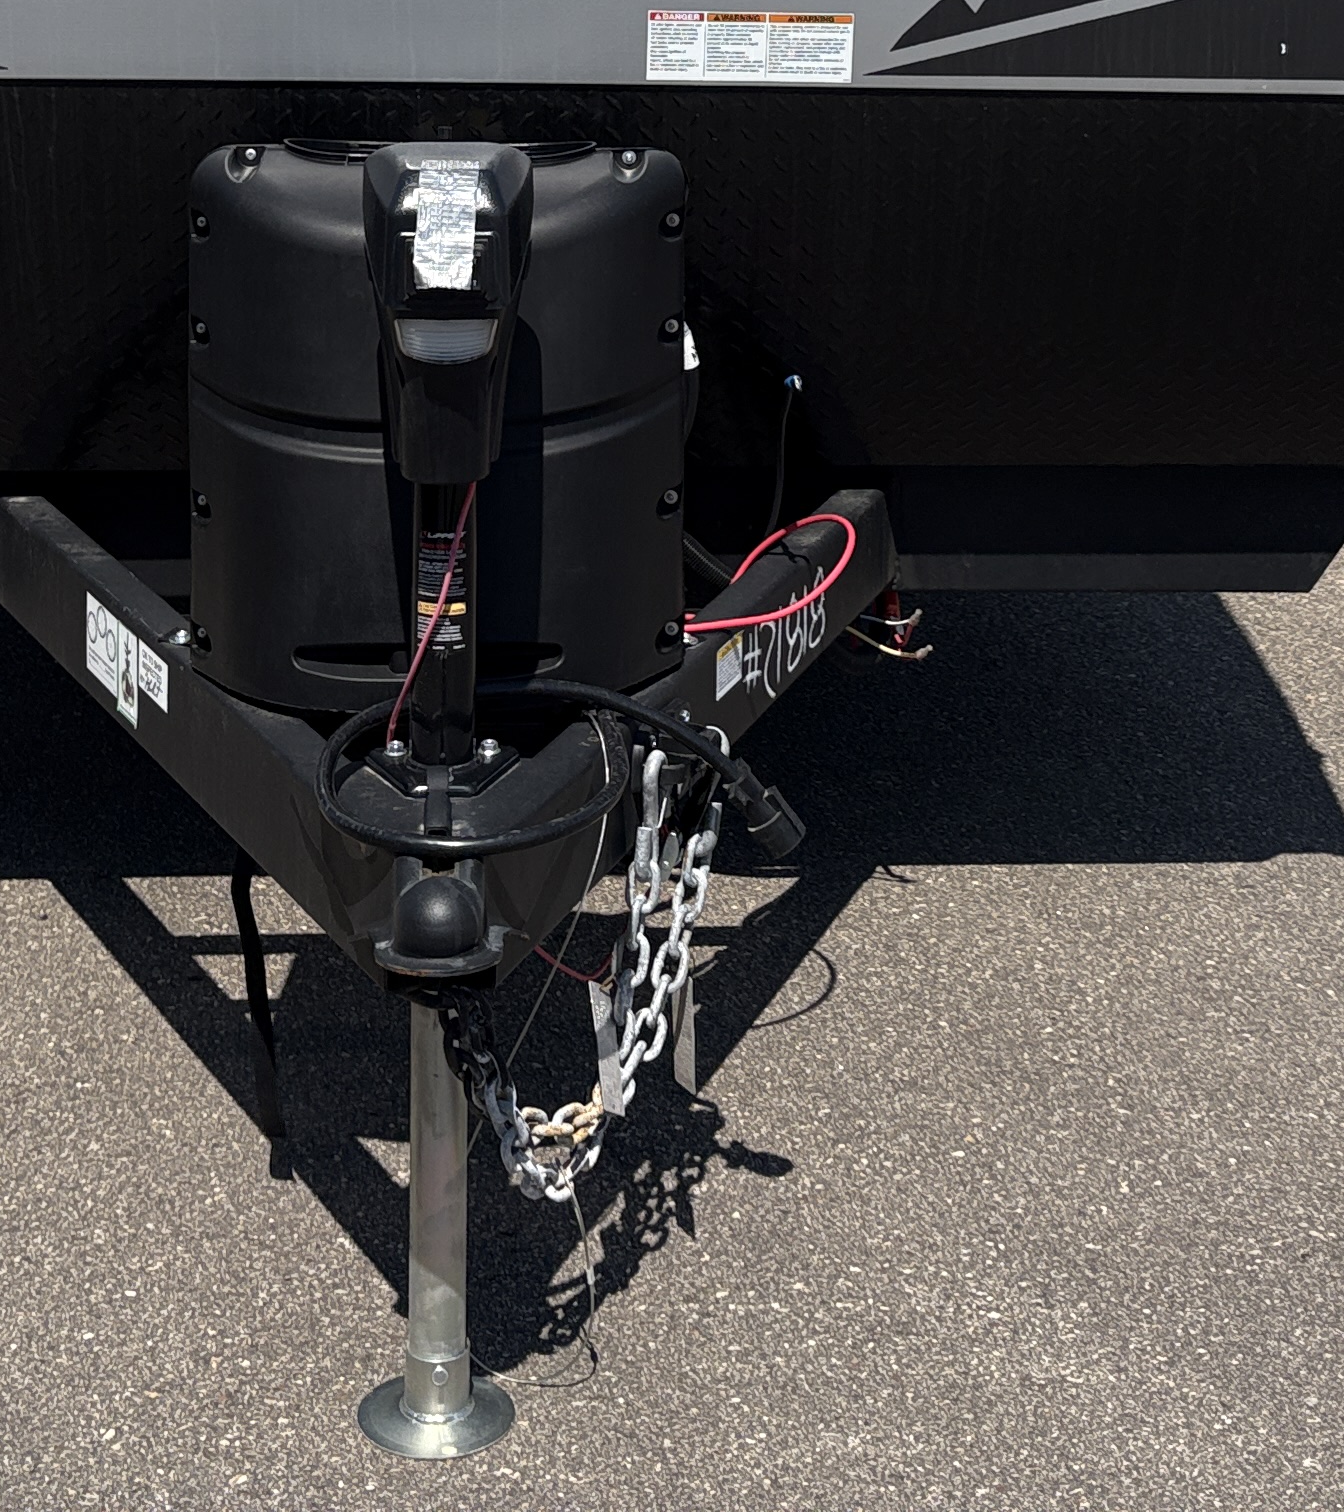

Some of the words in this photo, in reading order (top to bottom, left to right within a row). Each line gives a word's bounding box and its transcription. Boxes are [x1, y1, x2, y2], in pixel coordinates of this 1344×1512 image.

[662, 12, 701, 21] DANGER
[721, 14, 761, 22] WARNING
[795, 15, 835, 23] WARNING
